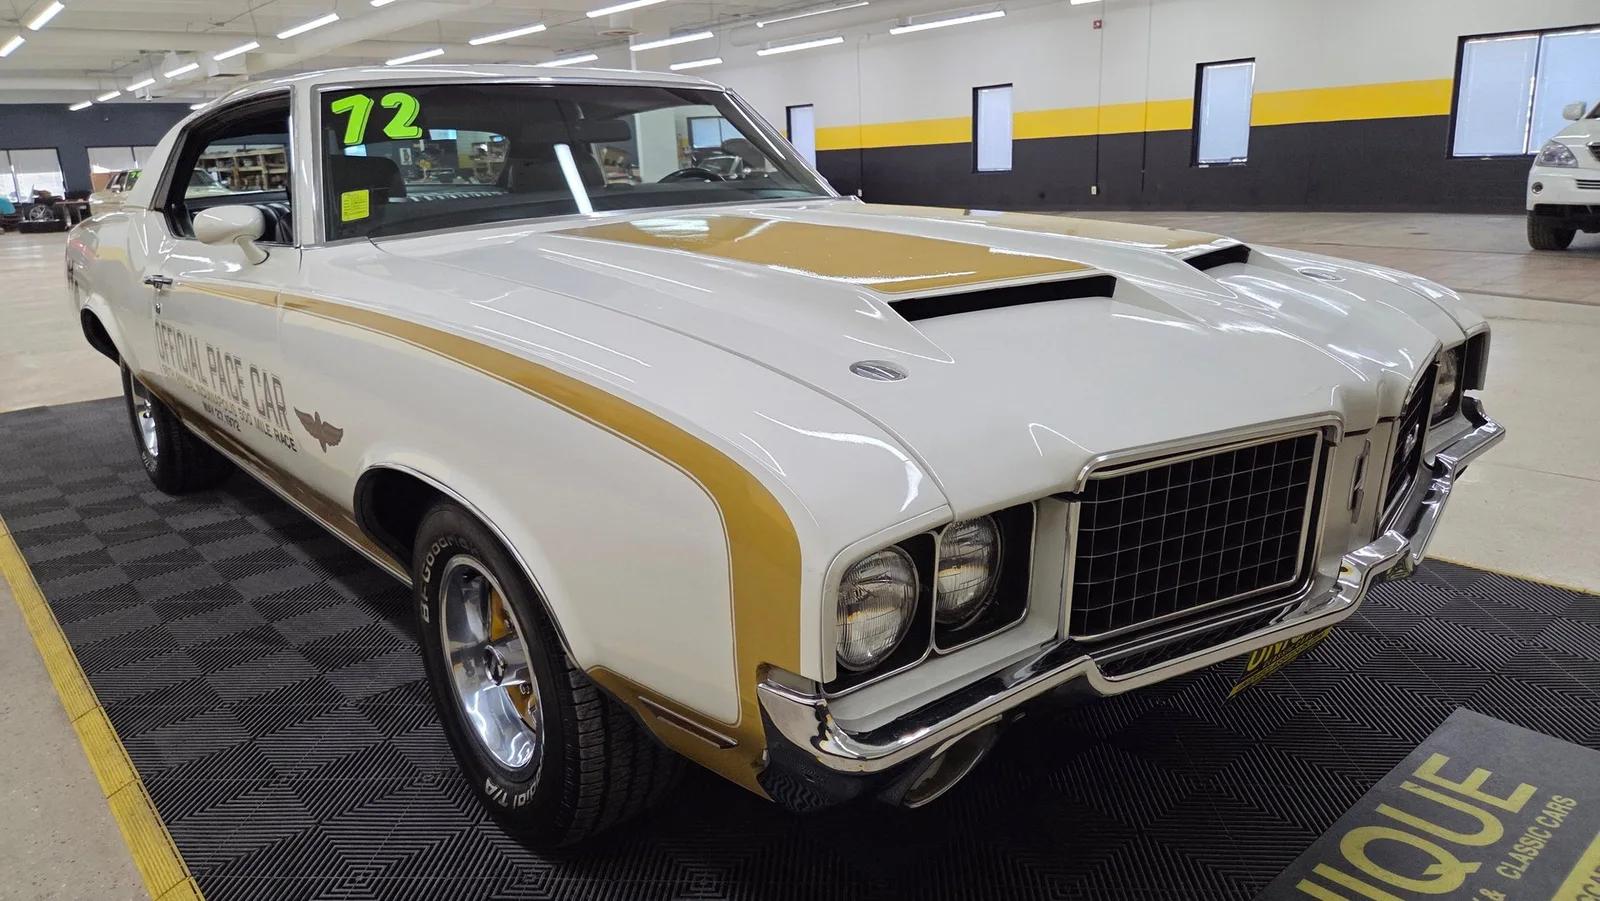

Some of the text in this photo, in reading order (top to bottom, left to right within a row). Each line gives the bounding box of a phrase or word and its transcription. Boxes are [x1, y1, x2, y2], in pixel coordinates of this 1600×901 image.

[331, 92, 423, 145] 72
[154, 320, 208, 386] OFFICIAL
[206, 343, 249, 407] PACE
[250, 364, 291, 432] CAR
[273, 427, 298, 453] RACE
[1296, 752, 1538, 901] IQUE
[1495, 826, 1553, 880] CLASSIC
[1535, 794, 1578, 829] CARS
